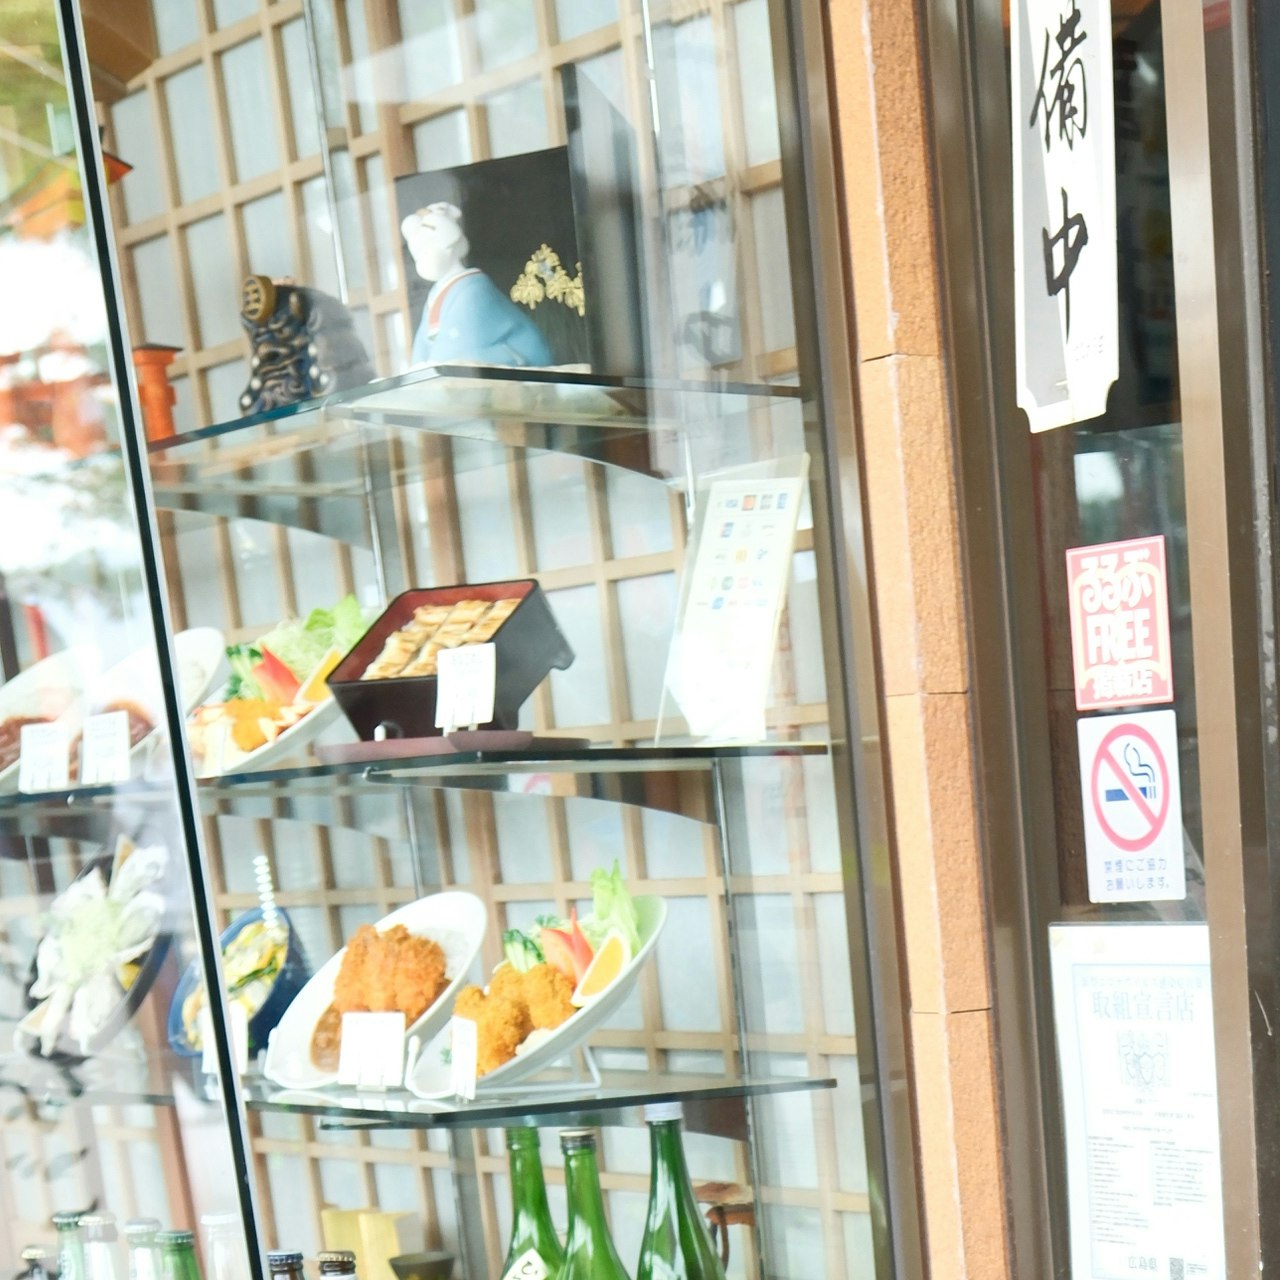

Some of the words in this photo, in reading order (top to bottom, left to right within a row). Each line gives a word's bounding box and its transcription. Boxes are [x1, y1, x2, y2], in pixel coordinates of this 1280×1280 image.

[1080, 549, 1152, 614] るるぶ
[1086, 608, 1153, 665] FREE
